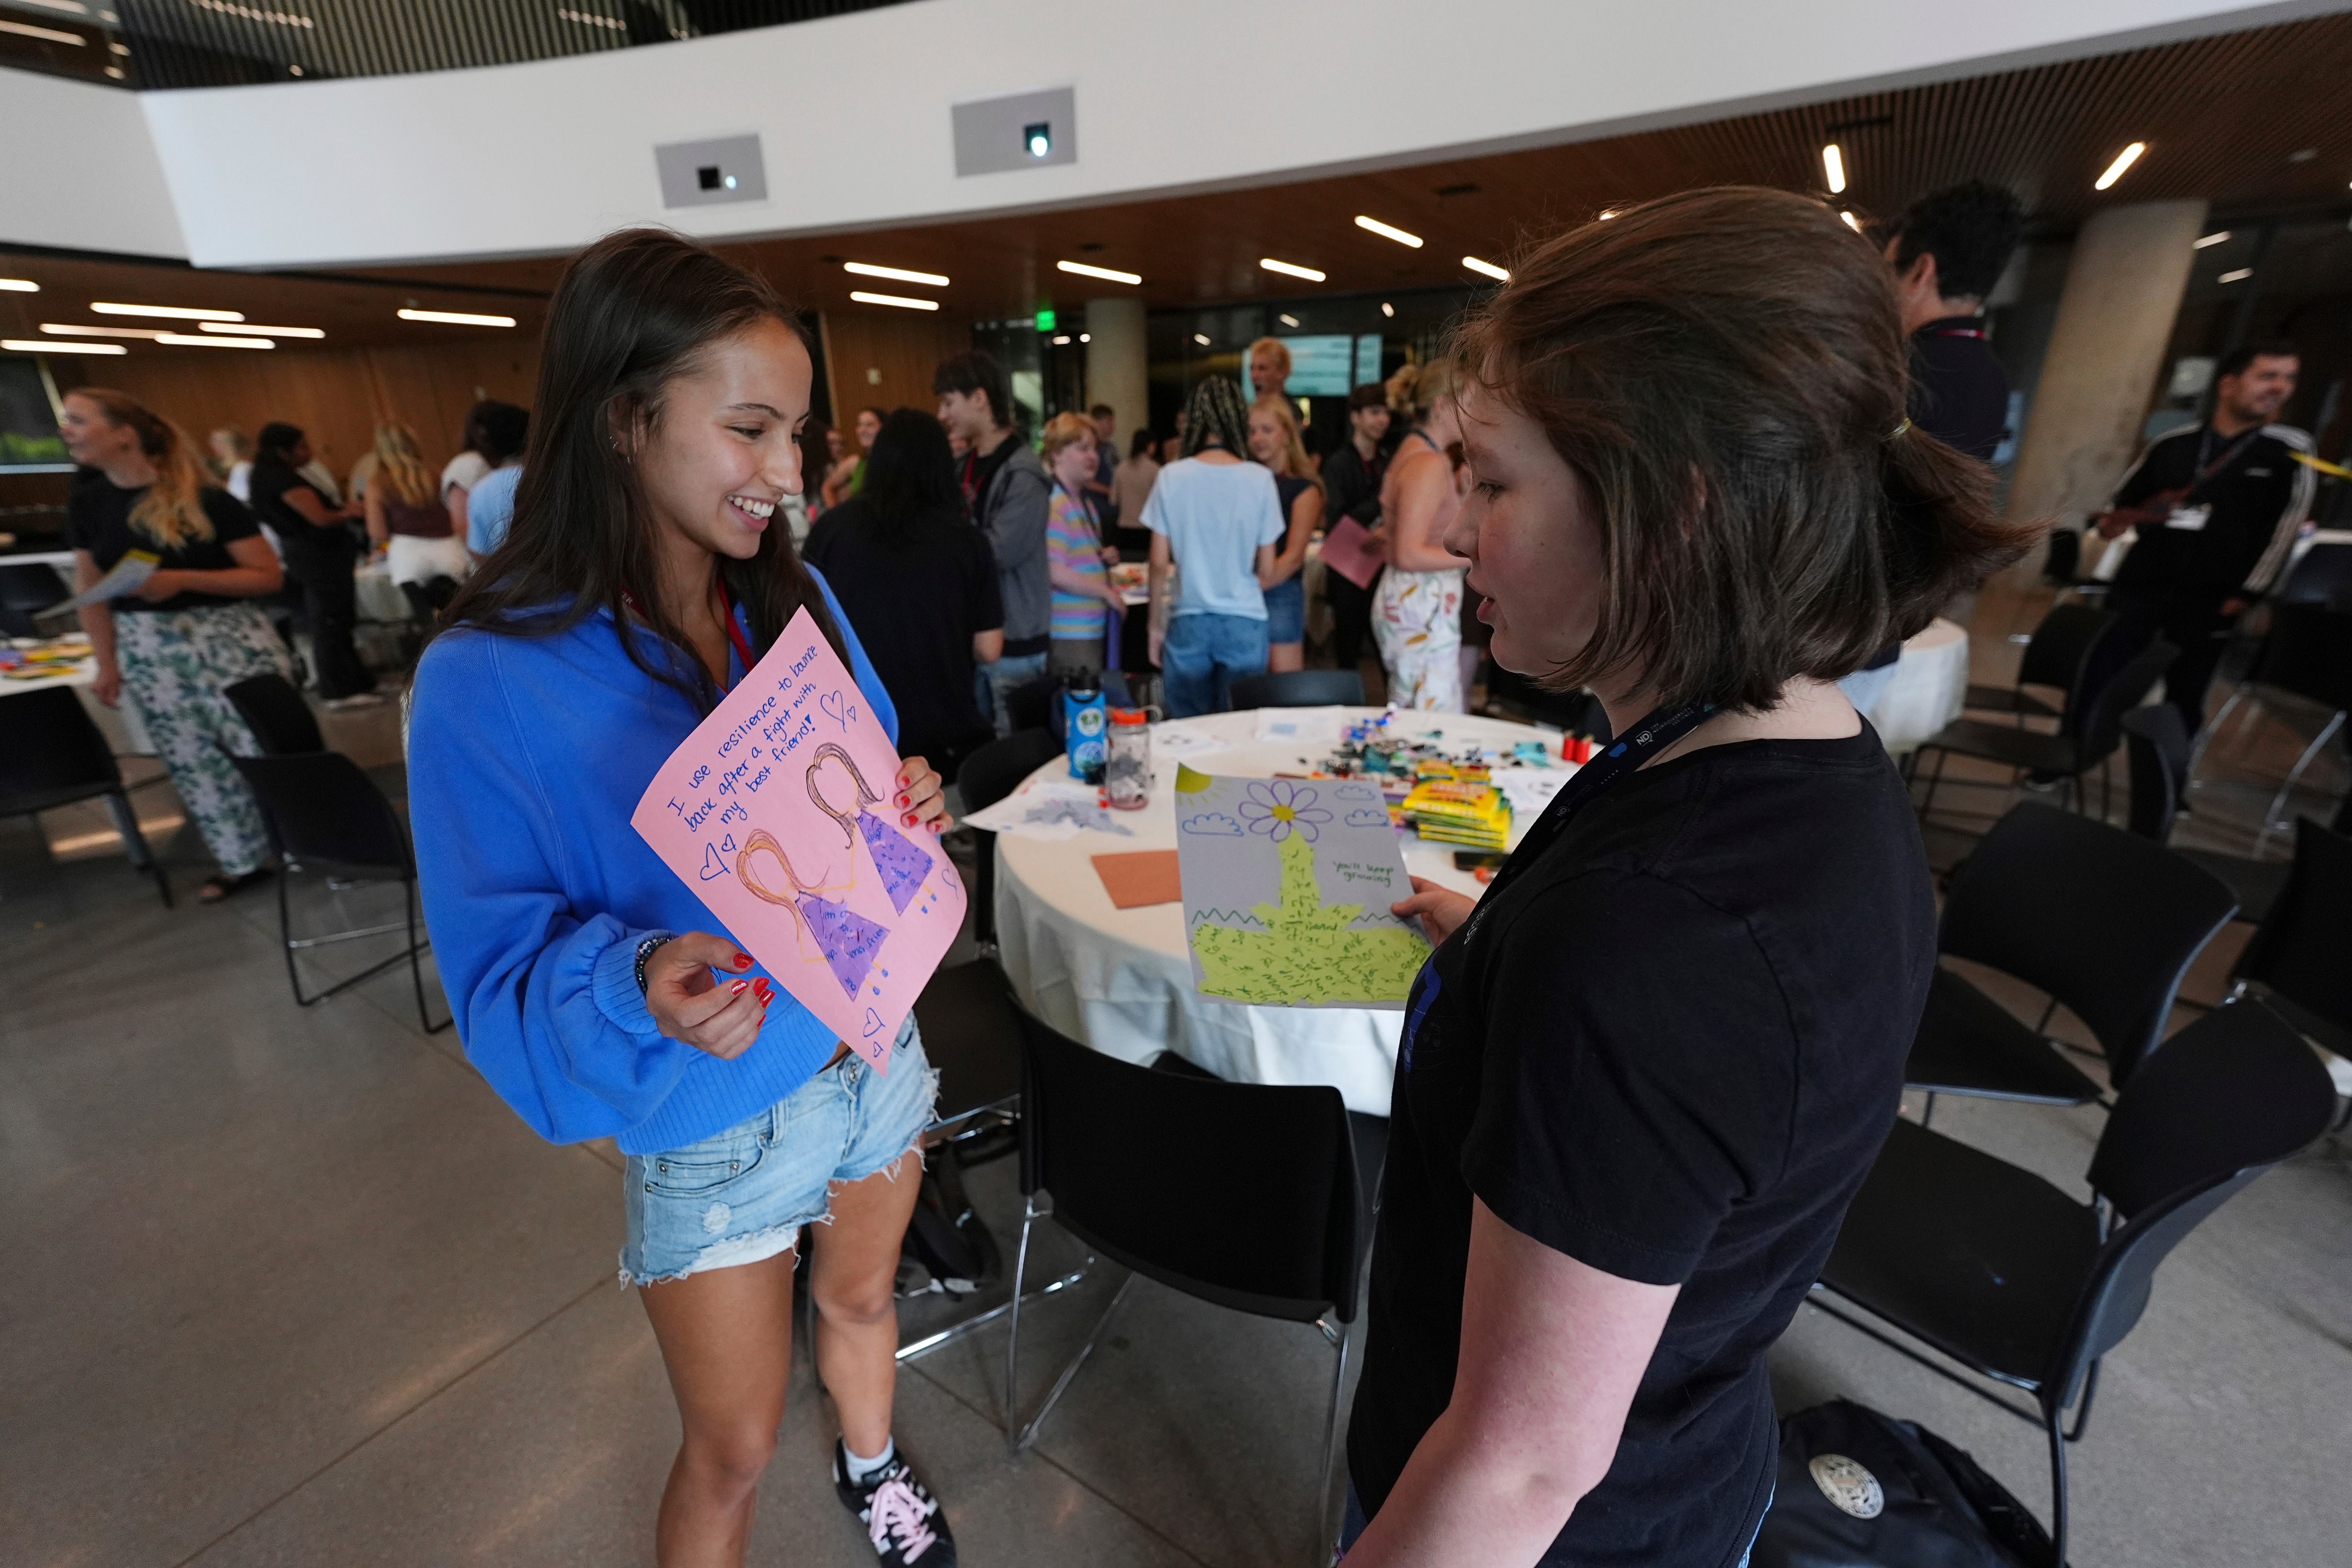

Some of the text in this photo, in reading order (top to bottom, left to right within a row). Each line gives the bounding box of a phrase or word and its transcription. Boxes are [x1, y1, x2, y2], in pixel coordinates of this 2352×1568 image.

[668, 646, 817, 817] I use resilience to bounce
[684, 683, 817, 832] back after a fight with
[720, 714, 816, 824] my best friend!
[1636, 733, 1650, 745] ND
